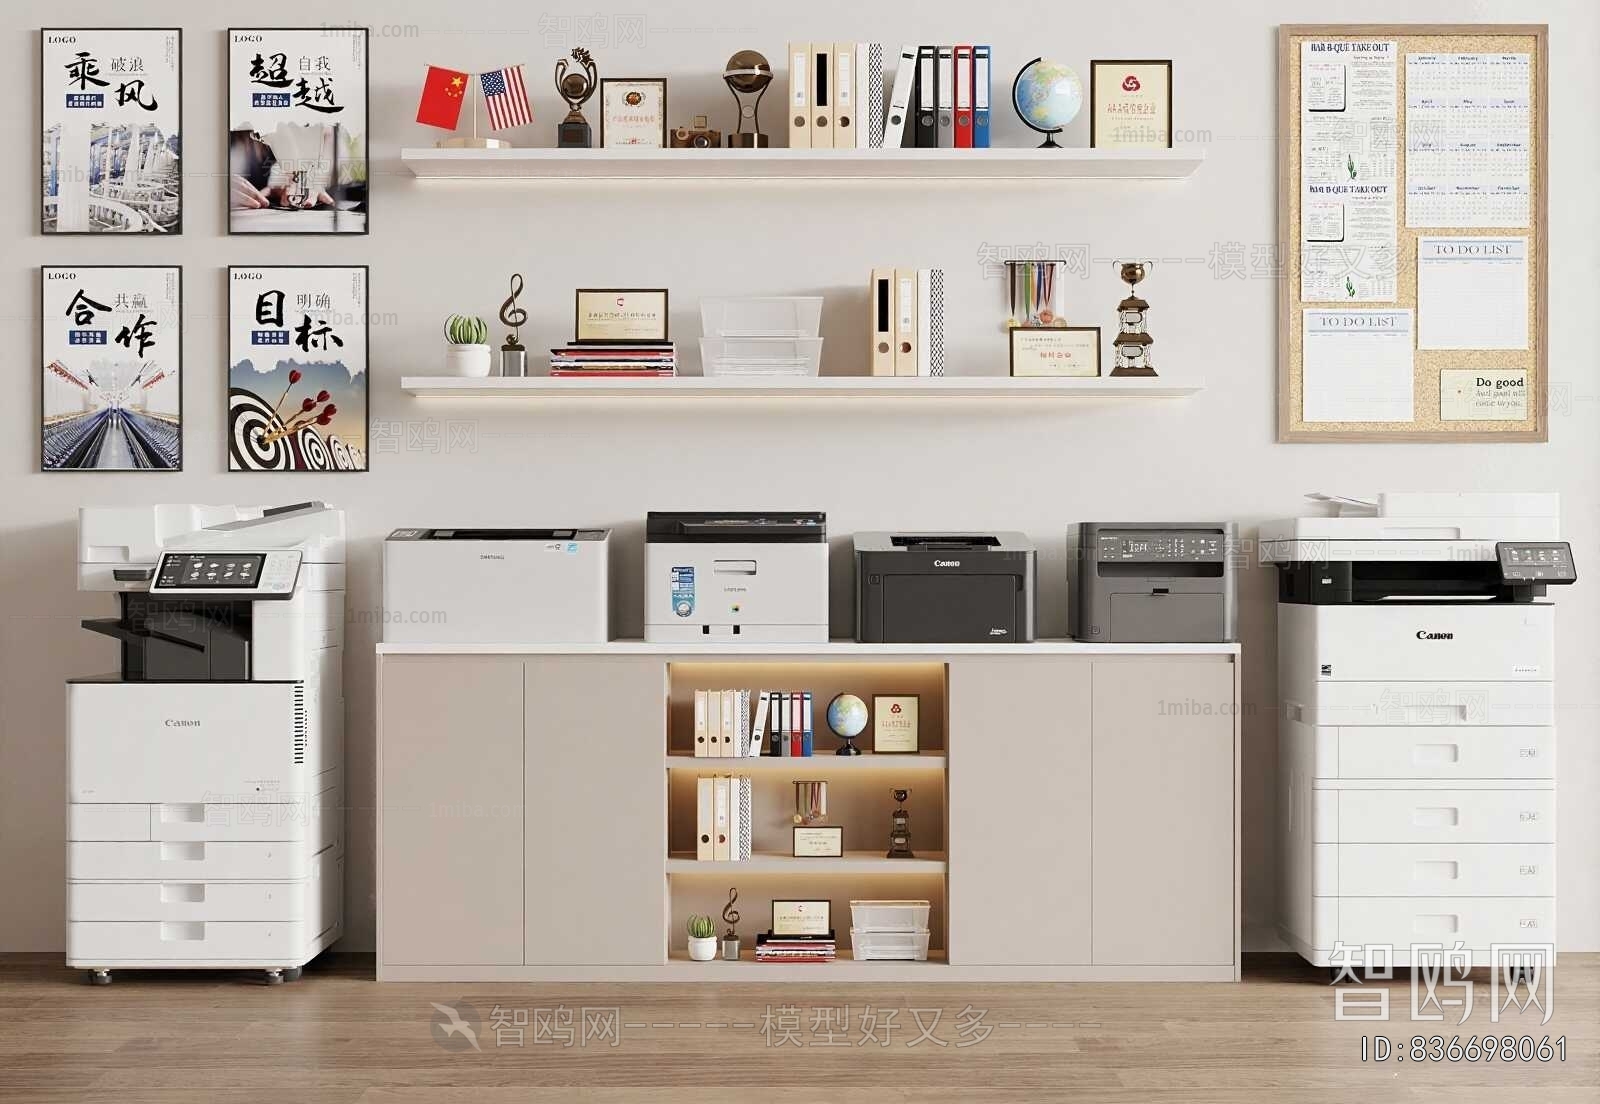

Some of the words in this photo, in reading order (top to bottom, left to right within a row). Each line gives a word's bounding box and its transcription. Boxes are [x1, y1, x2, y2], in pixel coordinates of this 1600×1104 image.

[48, 36, 76, 44] LOGO
[234, 35, 263, 43] LOGO
[1351, 43, 1373, 52] TAKE
[1373, 43, 1390, 52] OUT
[111, 56, 144, 72] 破浪
[299, 56, 331, 71] 自我
[1433, 244, 1454, 254] TO
[1458, 244, 1480, 254] DO
[1484, 244, 1512, 254] LIST
[65, 289, 112, 326] 合
[255, 290, 285, 327] 目
[1319, 316, 1339, 326] TO
[1343, 316, 1365, 326] DO
[1369, 316, 1398, 326] LIST
[114, 313, 158, 359] 作
[294, 313, 344, 353] 标
[1476, 377, 1492, 387] Do
[1496, 377, 1524, 390] good
[934, 559, 960, 568] Canon
[1416, 630, 1453, 641] Canon
[164, 719, 201, 728] Canon
